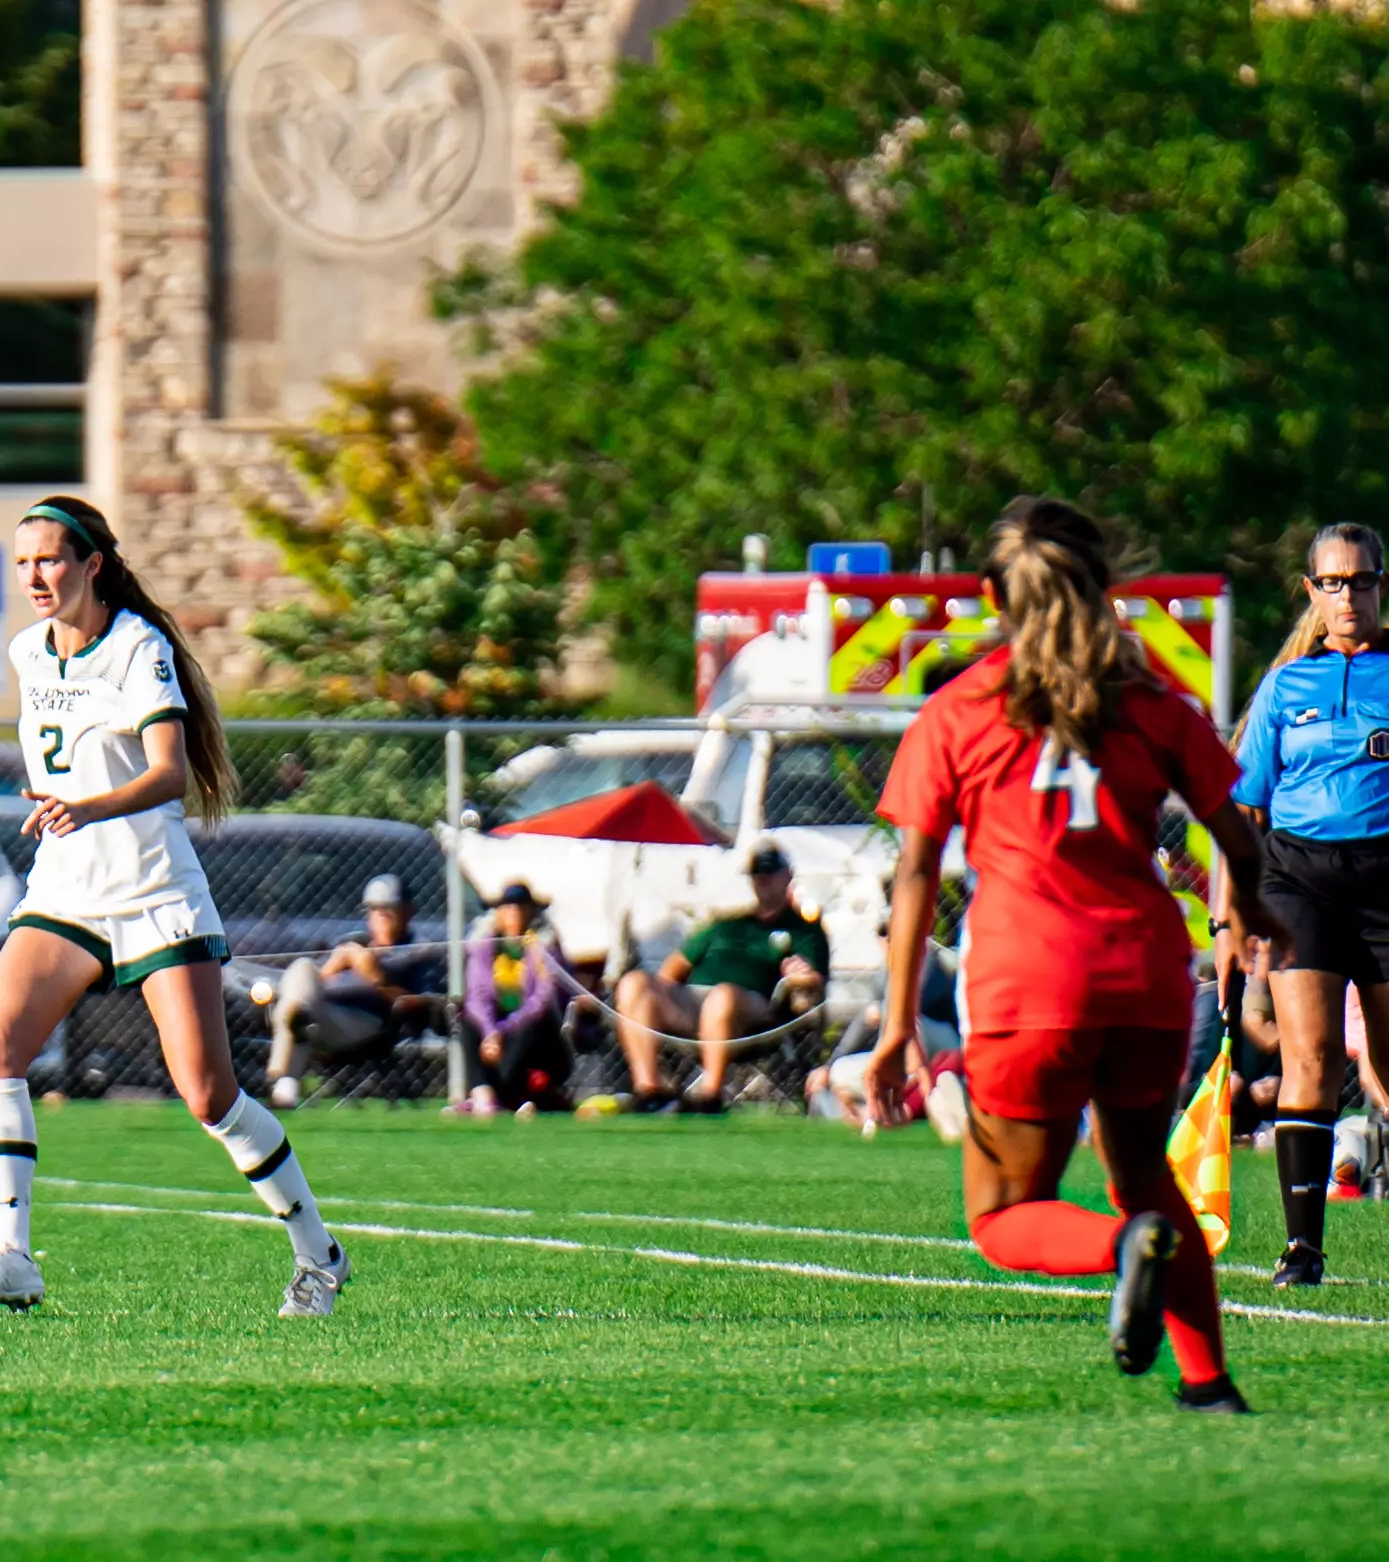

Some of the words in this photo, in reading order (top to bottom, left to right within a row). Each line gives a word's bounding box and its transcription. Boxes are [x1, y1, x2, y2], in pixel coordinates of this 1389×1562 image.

[32, 699, 75, 712] STATE
[39, 724, 71, 774] 2
[1030, 724, 1102, 830] 4
